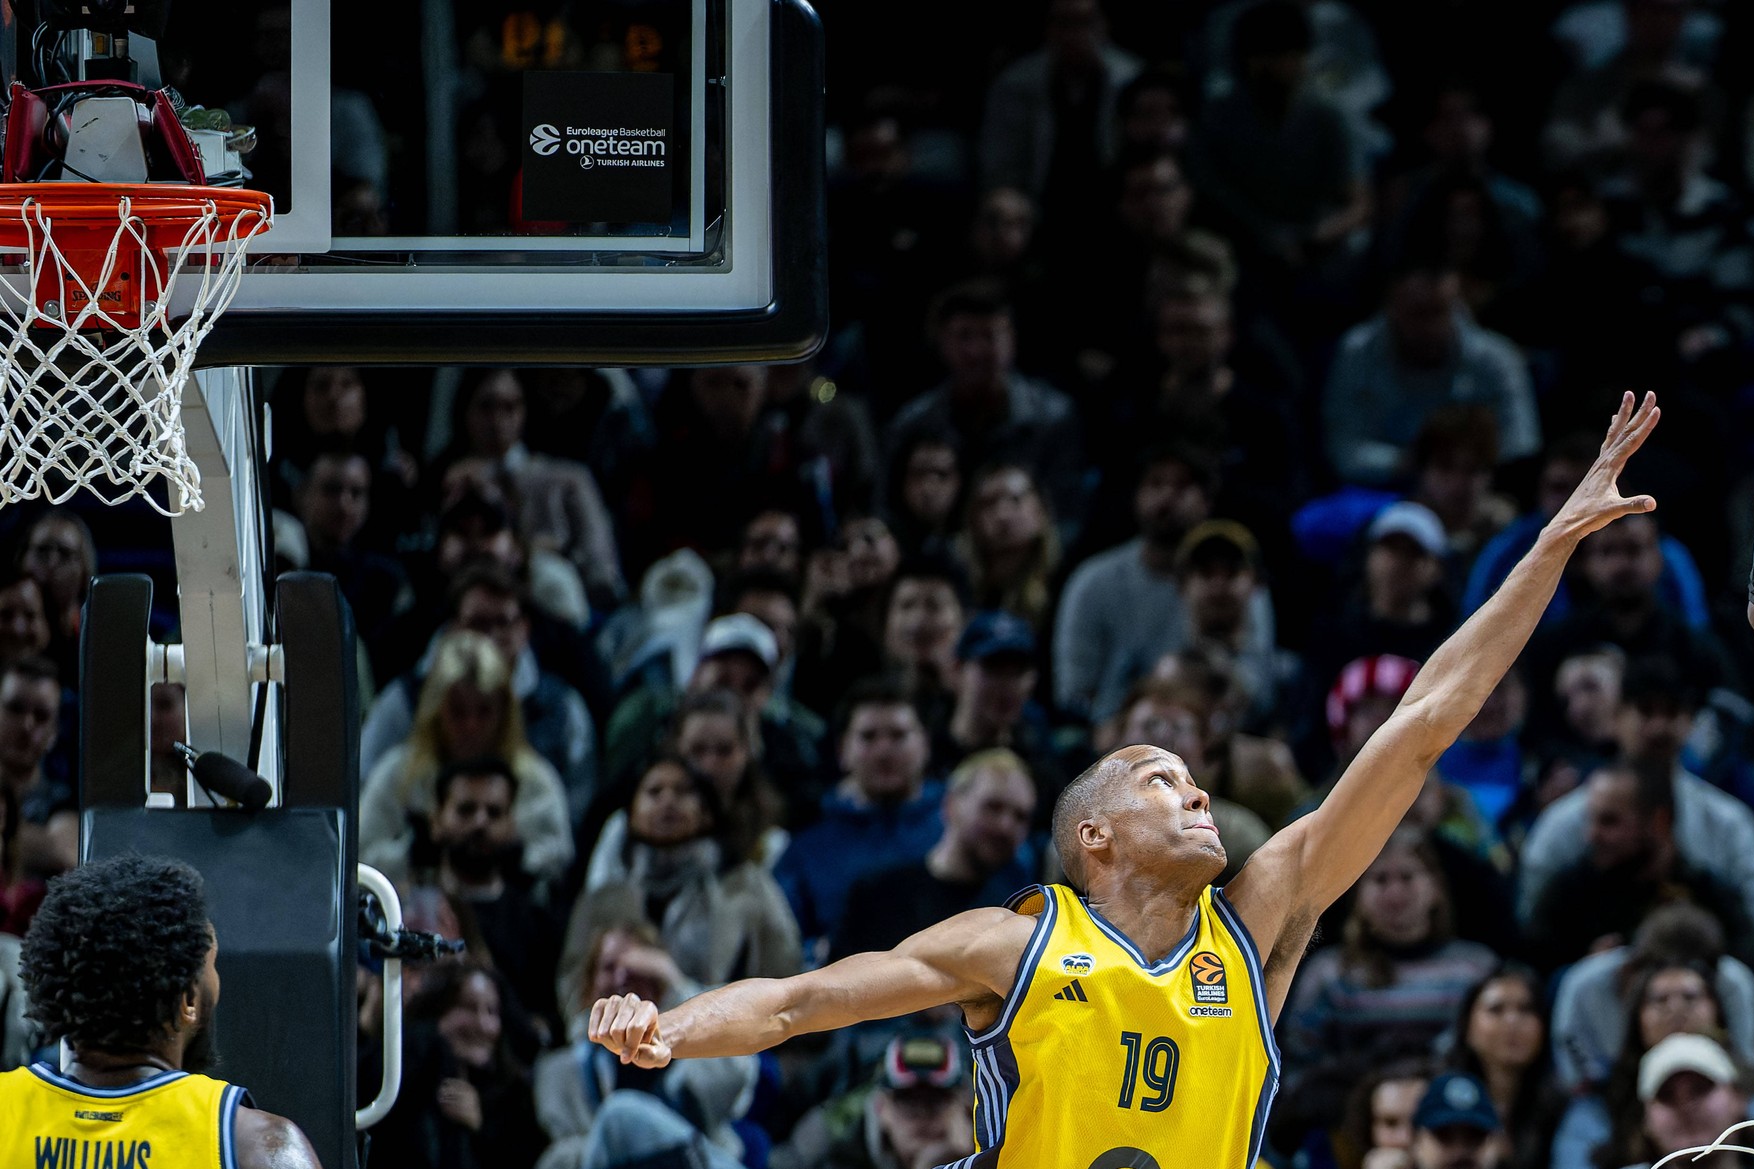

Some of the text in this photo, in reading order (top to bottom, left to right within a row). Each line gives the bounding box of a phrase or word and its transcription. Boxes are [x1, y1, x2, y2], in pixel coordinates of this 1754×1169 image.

[566, 127, 666, 138] Euroleague Basketball
[566, 137, 665, 155] oneteam
[1190, 1006, 1231, 1016] oneteam
[1118, 1031, 1180, 1113] 19
